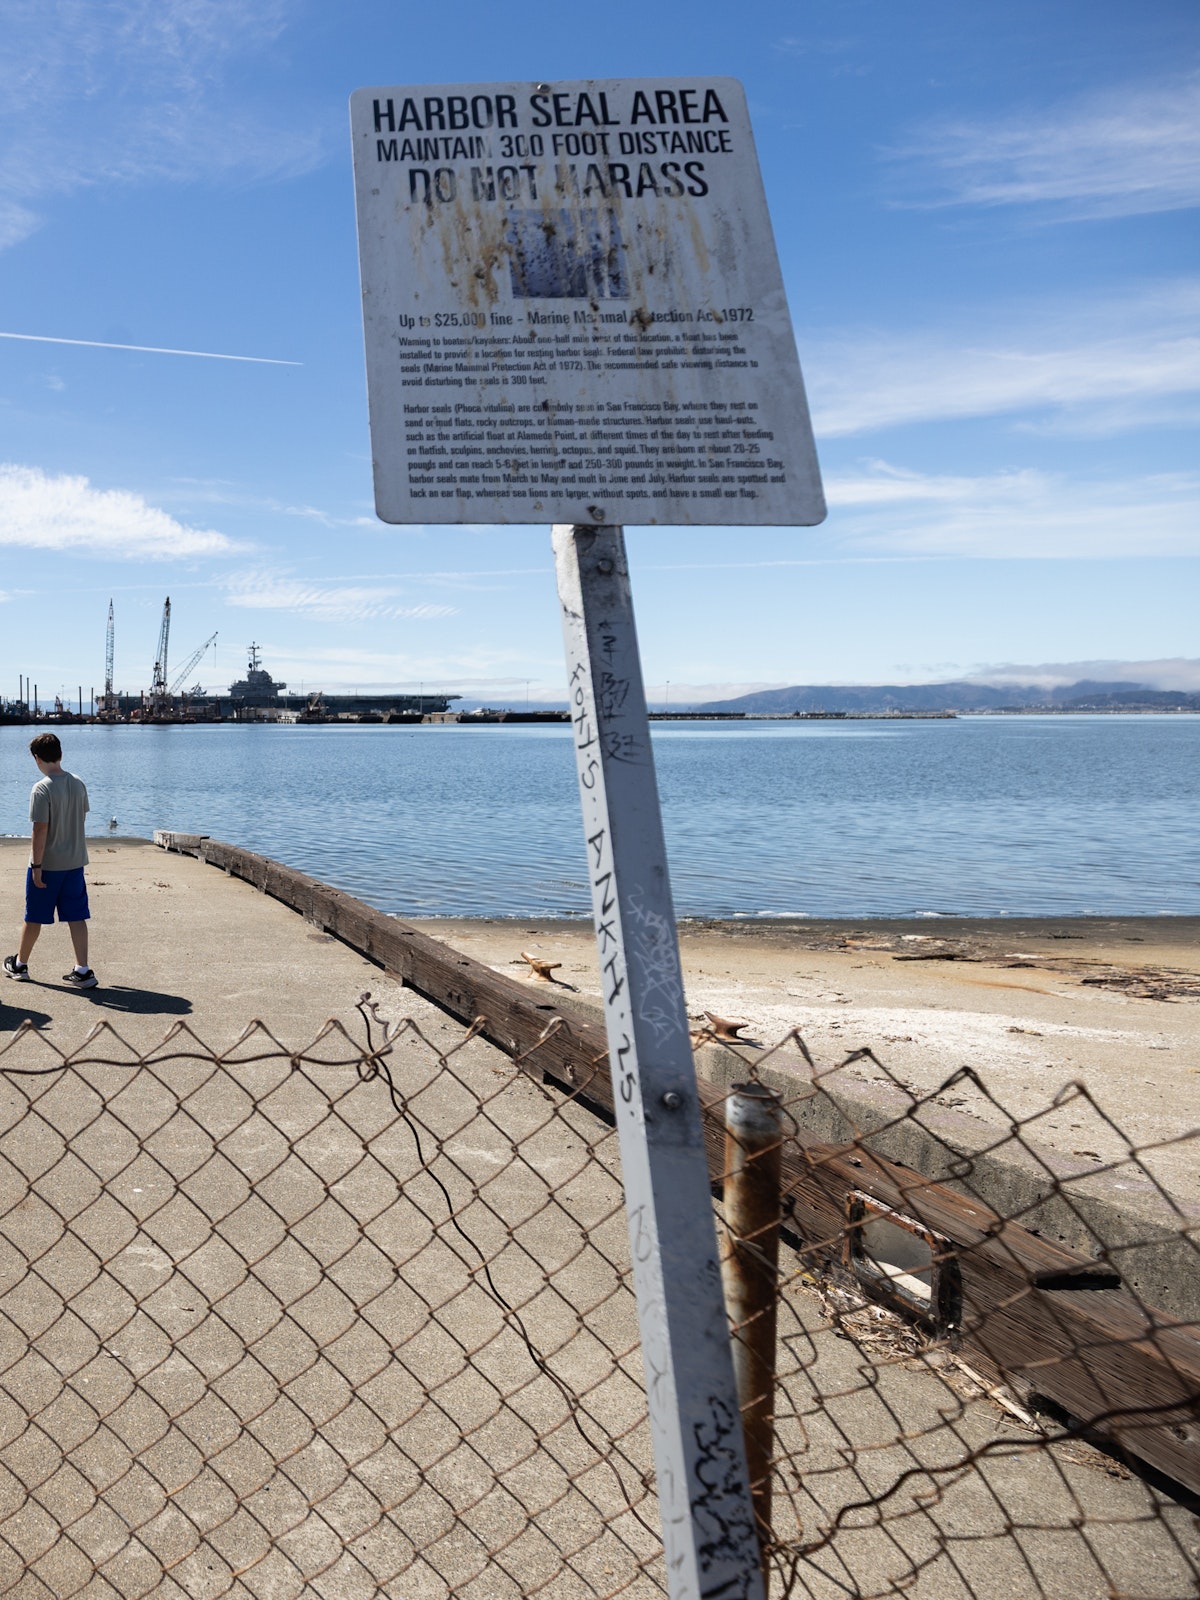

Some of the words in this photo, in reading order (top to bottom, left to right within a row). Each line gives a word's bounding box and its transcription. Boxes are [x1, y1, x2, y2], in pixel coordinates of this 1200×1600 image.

[373, 94, 518, 133] HARBOR
[530, 91, 620, 128] SEAL
[631, 89, 728, 125] AREA
[377, 136, 492, 162] MAINTAIN
[500, 134, 544, 158] 300
[552, 132, 610, 156] FOOT
[619, 130, 733, 154] DISTANCE
[409, 167, 457, 203] DO
[471, 165, 538, 200] NOT
[400, 314, 415, 330] Up
[490, 311, 513, 325] fine
[528, 311, 570, 324] Marine
[722, 308, 755, 322] 1972
[399, 337, 430, 347] Warning
[400, 350, 432, 360] installed
[514, 348, 525, 358] for
[528, 348, 554, 359] resting
[556, 347, 581, 358] harbor
[607, 347, 636, 356] Federal
[733, 345, 746, 355] the
[401, 363, 420, 373] seals
[423, 362, 453, 374] (Marine
[491, 361, 531, 371] Protection
[533, 360, 546, 371] Act
[559, 360, 586, 372] 1972).
[587, 360, 601, 370] The
[661, 359, 678, 369] safe
[680, 359, 713, 370] viewing
[750, 358, 759, 368] to
[401, 376, 423, 386] avoid
[425, 376, 462, 388] disturbing
[464, 376, 477, 386] the
[502, 375, 509, 385] is
[511, 374, 527, 385] 300
[529, 374, 548, 385] feet.
[403, 403, 429, 413] Harbor
[431, 403, 452, 413] seals
[454, 403, 481, 414] (Phoca
[483, 402, 516, 414] vitulina)
[518, 404, 531, 412] are
[597, 402, 605, 411] in
[606, 401, 622, 411] San
[623, 401, 661, 411] Francisco
[663, 400, 680, 412] Bay,
[710, 400, 727, 412] they
[730, 401, 746, 410] rest
[748, 402, 759, 410] on
[405, 417, 424, 428] sand
[425, 419, 433, 427] or
[435, 418, 453, 427] mud
[454, 417, 475, 428] flats,
[476, 417, 498, 429] rocky
[500, 417, 536, 428] outcrops,
[537, 418, 545, 426] or
[602, 416, 644, 426] structures.
[645, 415, 673, 425] Harbor
[698, 416, 713, 424] use
[406, 431, 424, 441] such
[426, 433, 436, 441] as
[437, 431, 450, 441] the
[452, 430, 485, 441] artificial
[487, 430, 505, 440] float
[507, 431, 515, 440] at
[517, 430, 552, 440] Alameda
[554, 430, 578, 441] Point,
[579, 431, 587, 440] at
[590, 429, 624, 440] different
[626, 429, 648, 440] times
[650, 429, 659, 439] of
[661, 429, 674, 439] the
[676, 429, 690, 441] day
[692, 430, 701, 439] to
[704, 430, 720, 439] rest
[722, 429, 741, 439] after
[742, 428, 774, 441] feeding
[407, 447, 417, 455] on
[418, 445, 449, 456] flatfish,
[450, 445, 485, 456] sculpins,
[486, 444, 529, 455] anchovies,
[597, 444, 612, 454] and
[614, 444, 639, 456] squid.
[639, 443, 660, 455] They
[662, 446, 676, 454] are
[733, 443, 761, 454] 20-25
[408, 459, 437, 471] pounds
[438, 459, 453, 469] and
[455, 461, 470, 469] can
[471, 459, 494, 469] reach
[531, 459, 539, 469] in
[568, 459, 583, 469] and
[585, 458, 623, 469] 250-300
[624, 458, 654, 470] pounds
[708, 458, 725, 468] San
[726, 457, 765, 468] Francisco
[767, 457, 785, 470] Bay,
[409, 473, 434, 483] harbor
[436, 473, 458, 483] seals
[459, 474, 480, 483] mate
[482, 473, 501, 483] from
[502, 473, 529, 483] March
[530, 474, 538, 483] to
[541, 473, 559, 485] May
[561, 473, 576, 483] and
[578, 473, 596, 483] molt
[599, 473, 606, 483] in
[608, 473, 629, 483] June
[631, 473, 646, 483] and
[648, 472, 667, 485] July.
[668, 472, 696, 483] Harbor
[698, 472, 720, 483] seals
[722, 474, 736, 482] are
[737, 472, 769, 484] spotted
[770, 472, 786, 482] and
[410, 488, 428, 498] lack
[429, 490, 439, 498] an
[441, 490, 454, 498] ear
[456, 487, 474, 499] flap,
[475, 488, 511, 498] whereas
[512, 490, 528, 498] sea
[529, 487, 549, 498] lions
[551, 489, 563, 498] are
[565, 488, 590, 500] larger,
[592, 488, 624, 498] without
[626, 488, 651, 500] spots,
[653, 488, 668, 498] and
[670, 488, 690, 498] have
[700, 487, 722, 498] small
[724, 490, 738, 498] ear
[740, 487, 760, 500] flap.
